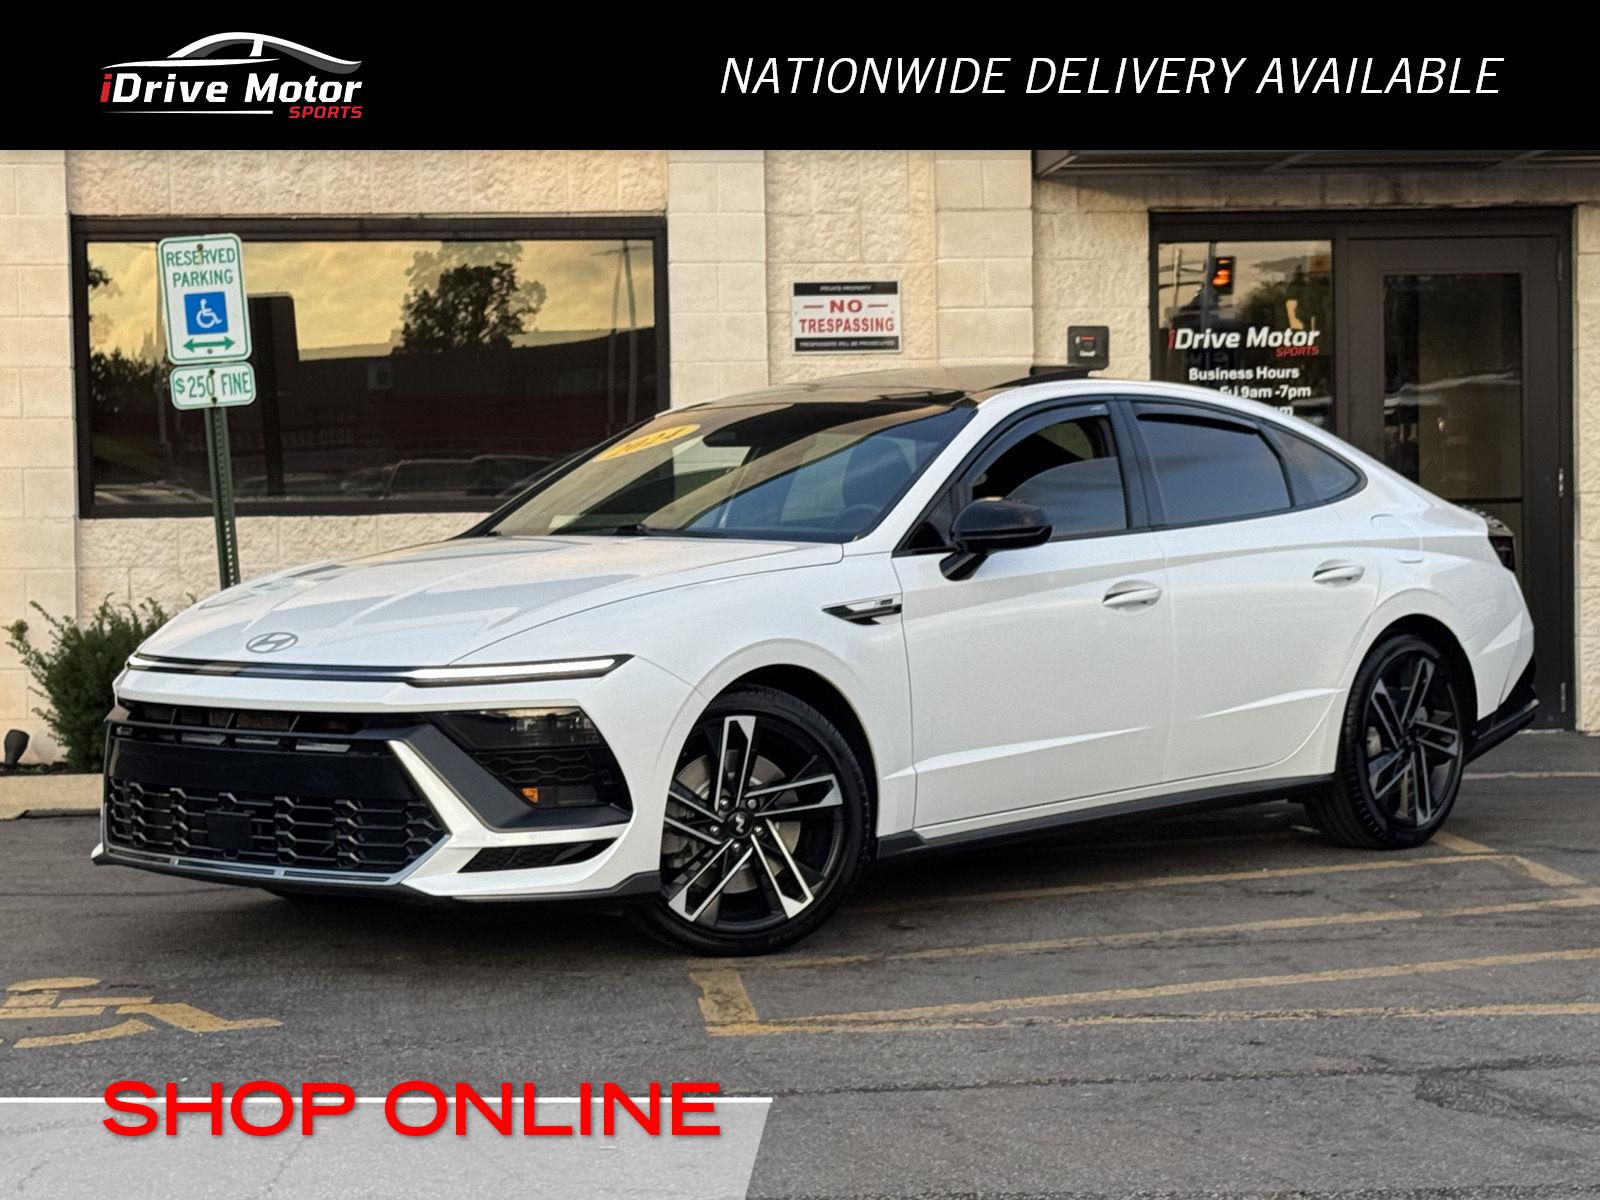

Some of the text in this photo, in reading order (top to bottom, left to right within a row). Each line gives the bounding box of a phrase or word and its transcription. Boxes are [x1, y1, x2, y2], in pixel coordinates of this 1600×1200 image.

[166, 248, 235, 267] RESERVED
[173, 269, 234, 288] PARKING
[829, 299, 862, 313] NO
[799, 317, 894, 333] TRESPASSING
[1246, 325, 1320, 349] Motor
[1275, 346, 1320, 357] SPORTS
[1188, 365, 1300, 381] Business Hours
[175, 372, 251, 398] $250 FINE
[1240, 385, 1273, 398] 9am
